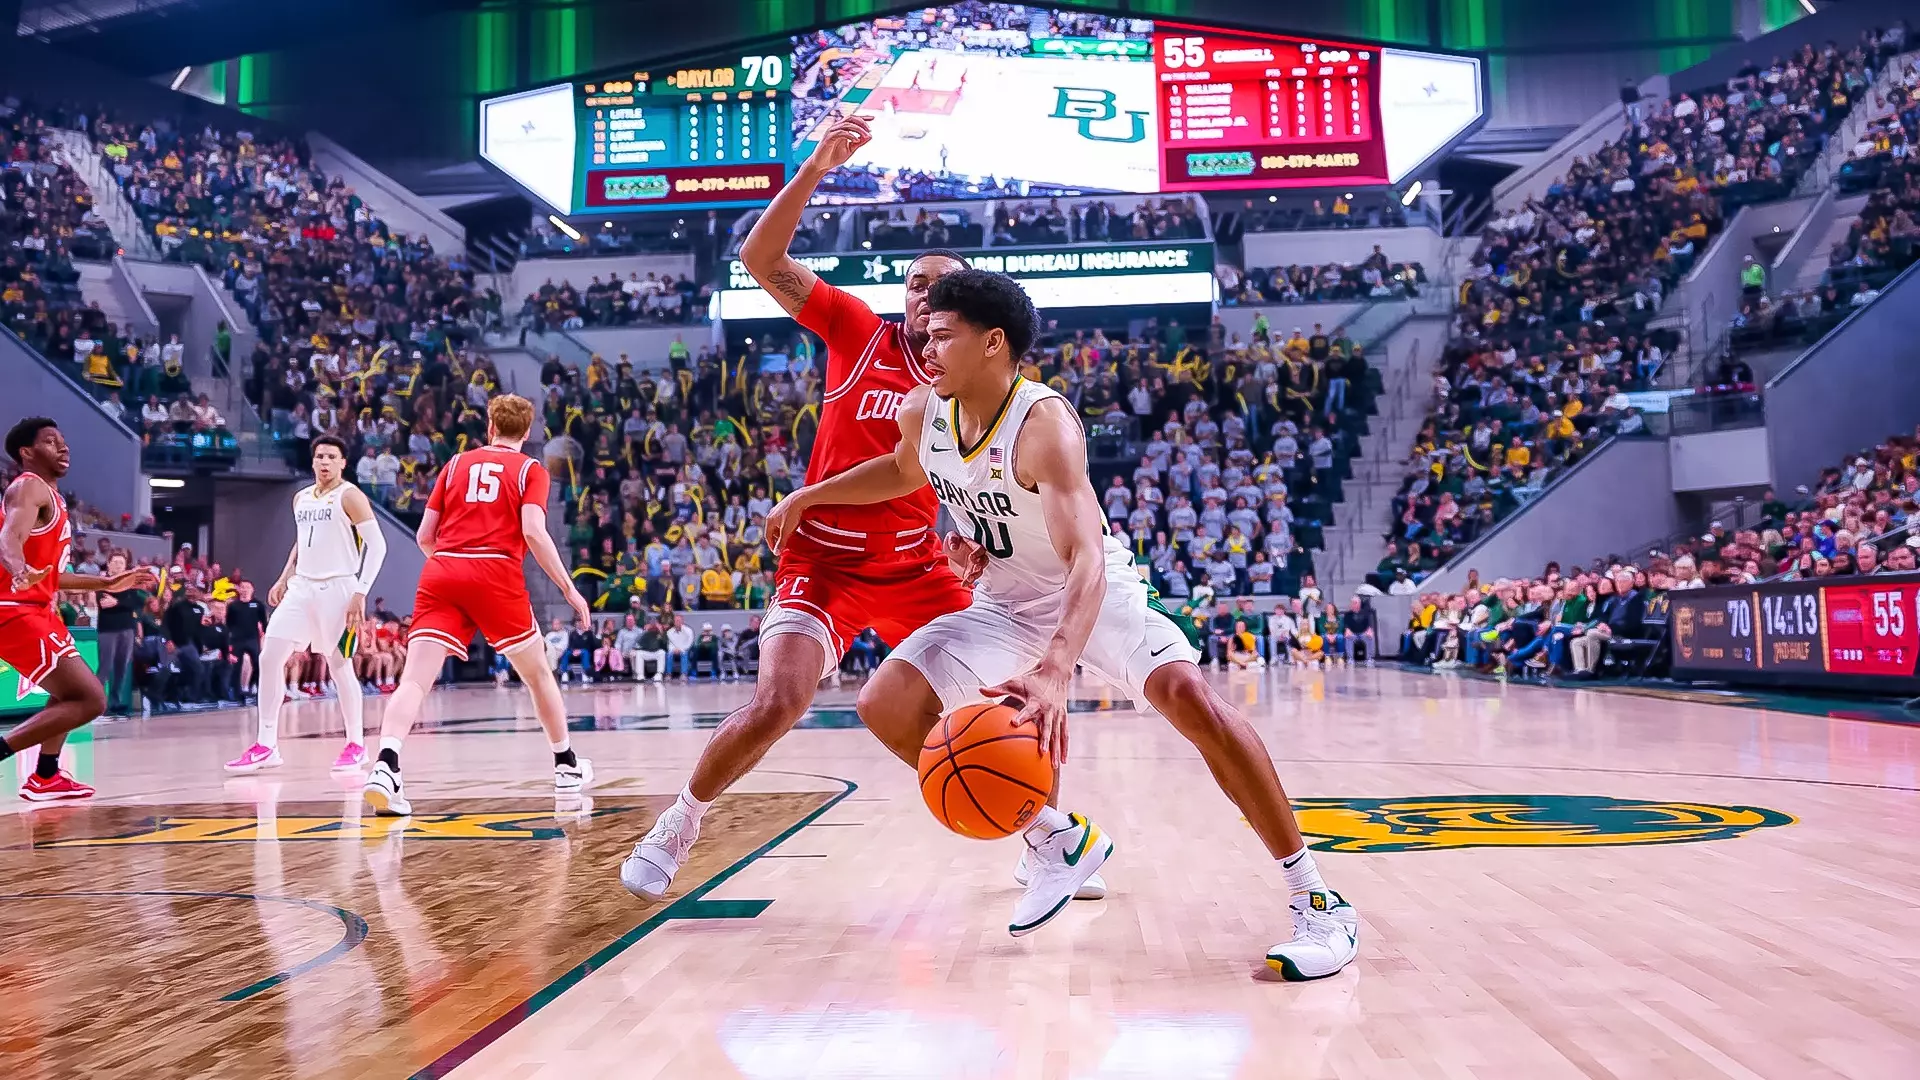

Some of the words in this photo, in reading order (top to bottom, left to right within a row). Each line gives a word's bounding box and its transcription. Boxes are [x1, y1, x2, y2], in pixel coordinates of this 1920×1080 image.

[1164, 37, 1205, 68] 55
[676, 68, 735, 89] BAYLOR
[741, 55, 783, 87] 70
[1048, 86, 1150, 143] BU
[1005, 253, 1079, 272] BUREAU
[1081, 249, 1188, 270] INSURANCE
[465, 462, 504, 502] 15
[929, 471, 1019, 516] BAYLOR
[297, 508, 332, 523] BAYLOR
[308, 525, 314, 547] 1
[790, 576, 810, 596] C
[1727, 599, 1751, 637] 70
[1763, 594, 1818, 635] 14:13
[1873, 591, 1905, 636] 55
[1312, 894, 1326, 910] BU
